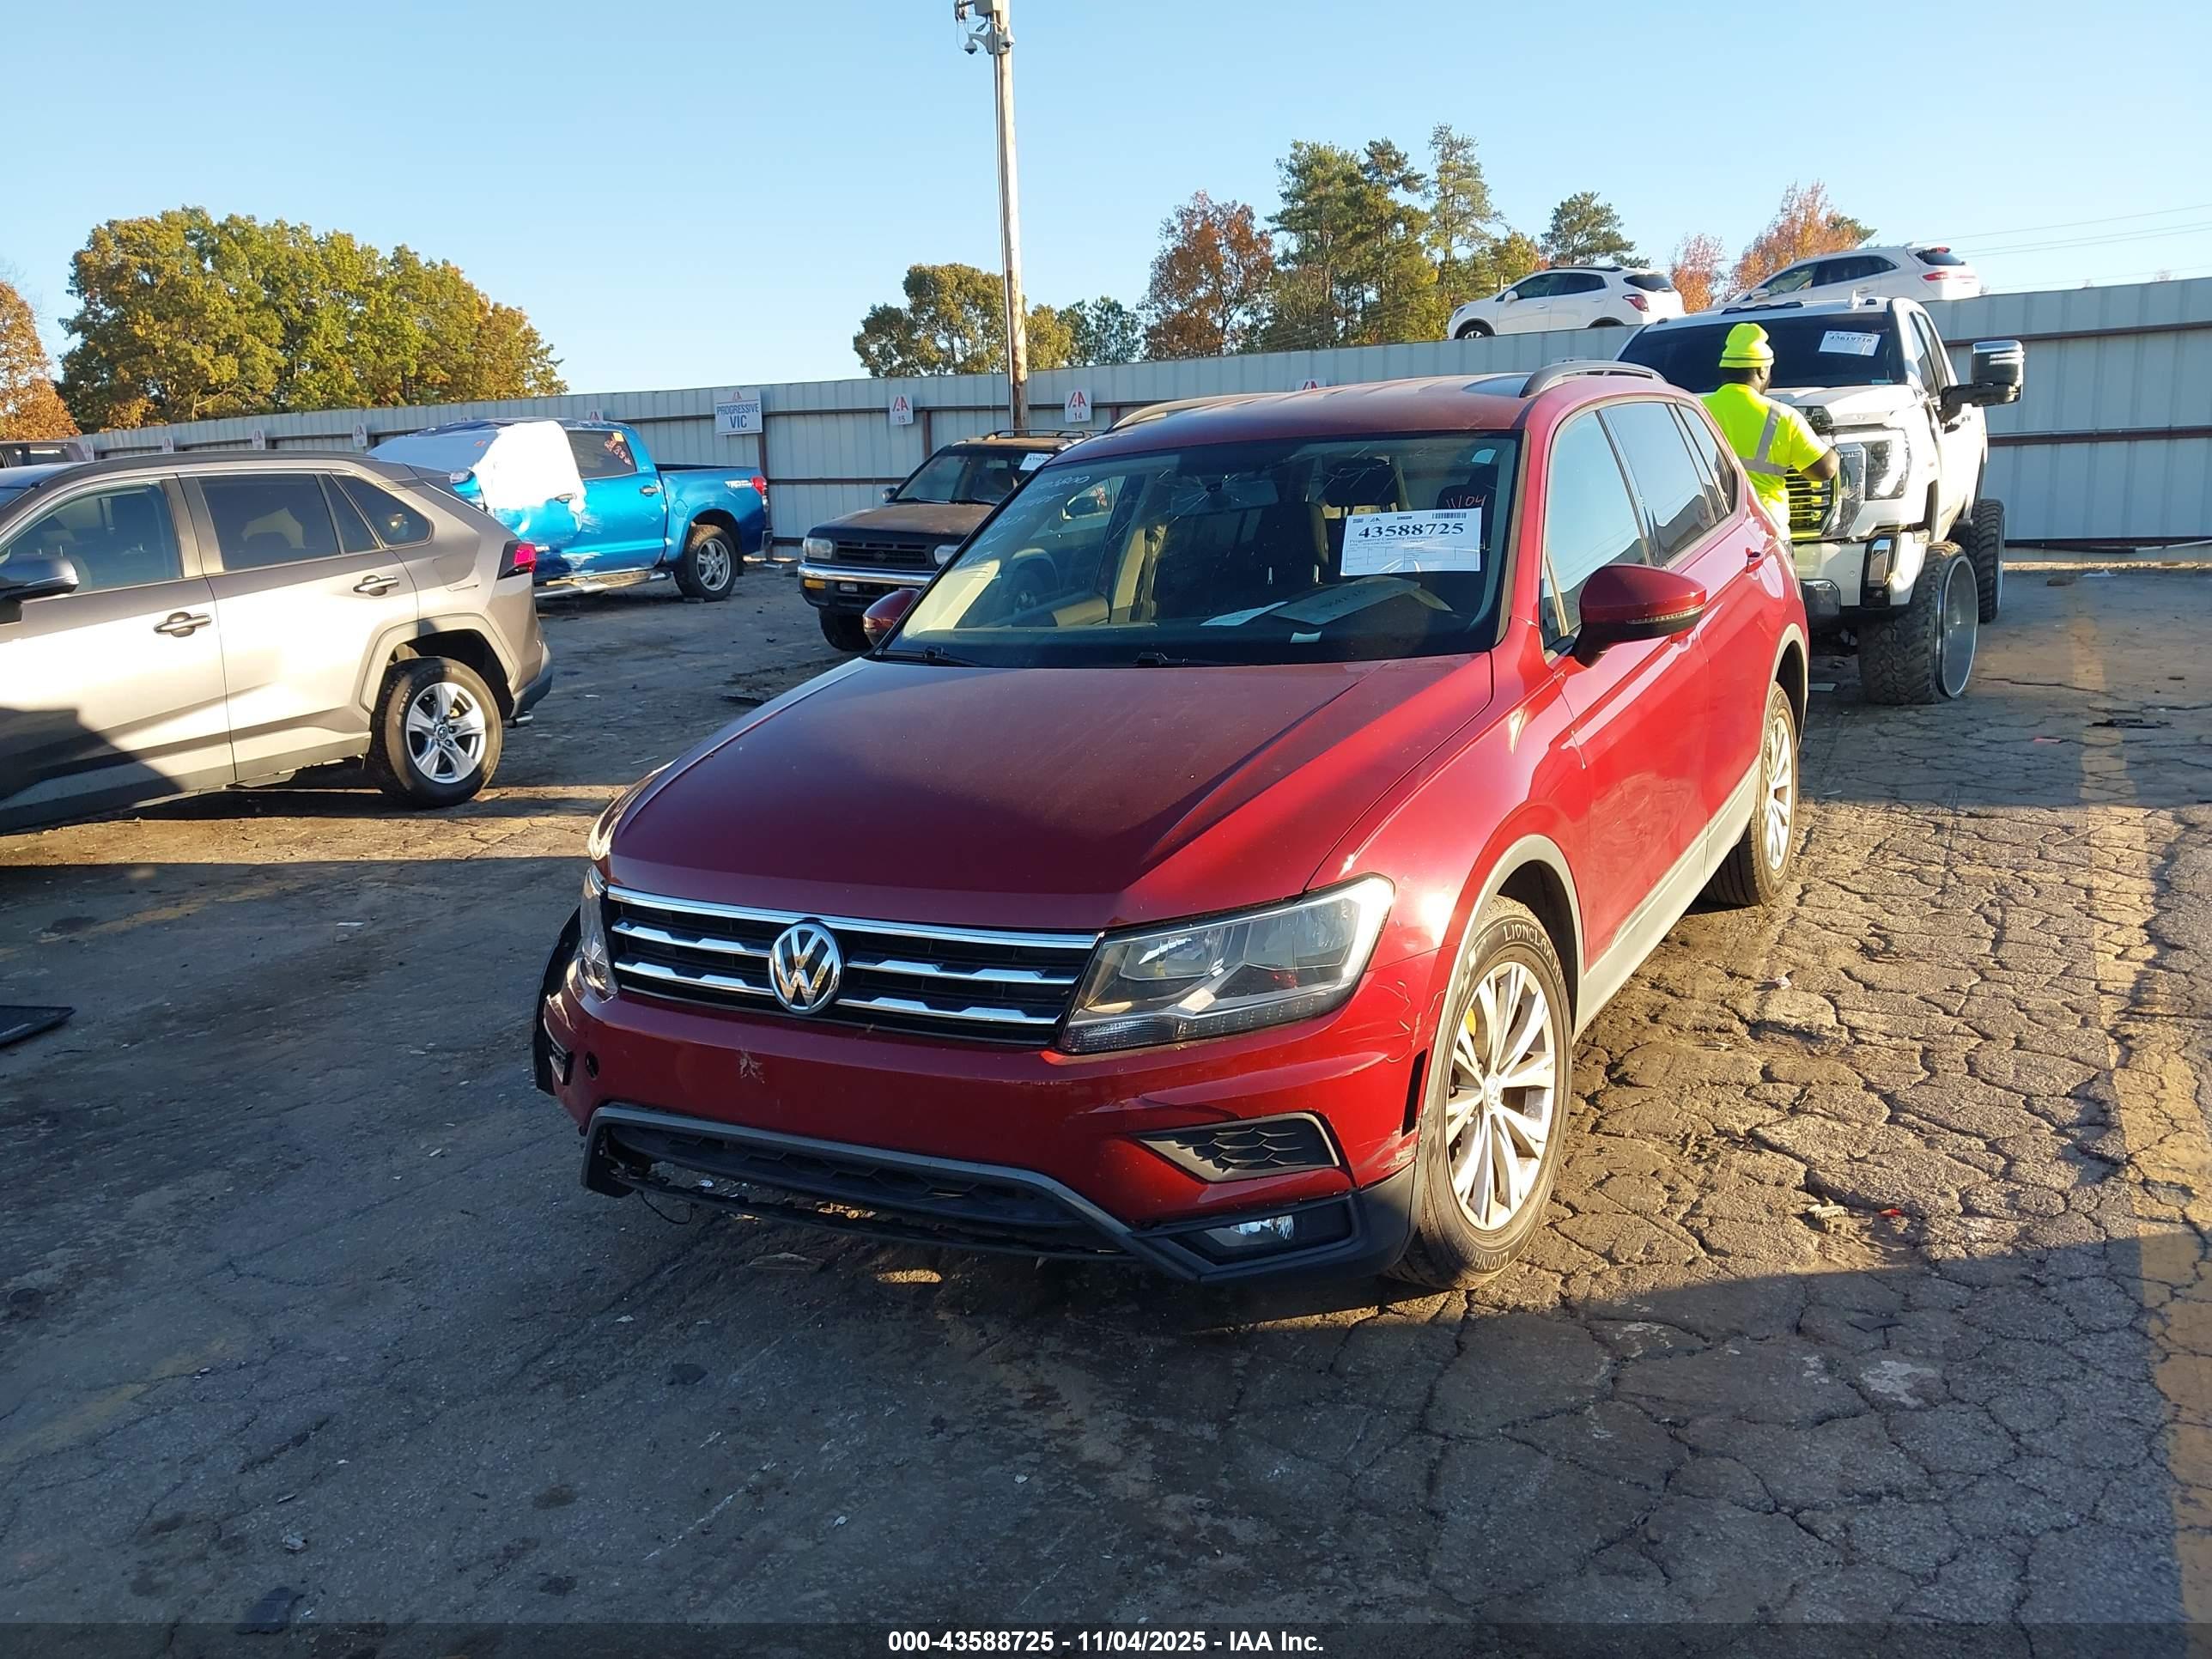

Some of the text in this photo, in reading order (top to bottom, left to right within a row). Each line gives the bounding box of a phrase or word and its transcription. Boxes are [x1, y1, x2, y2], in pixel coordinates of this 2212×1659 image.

[716, 404, 759, 415] PROGRESSIVE
[730, 415, 747, 428] VIC
[1358, 522, 1464, 538] 43588725
